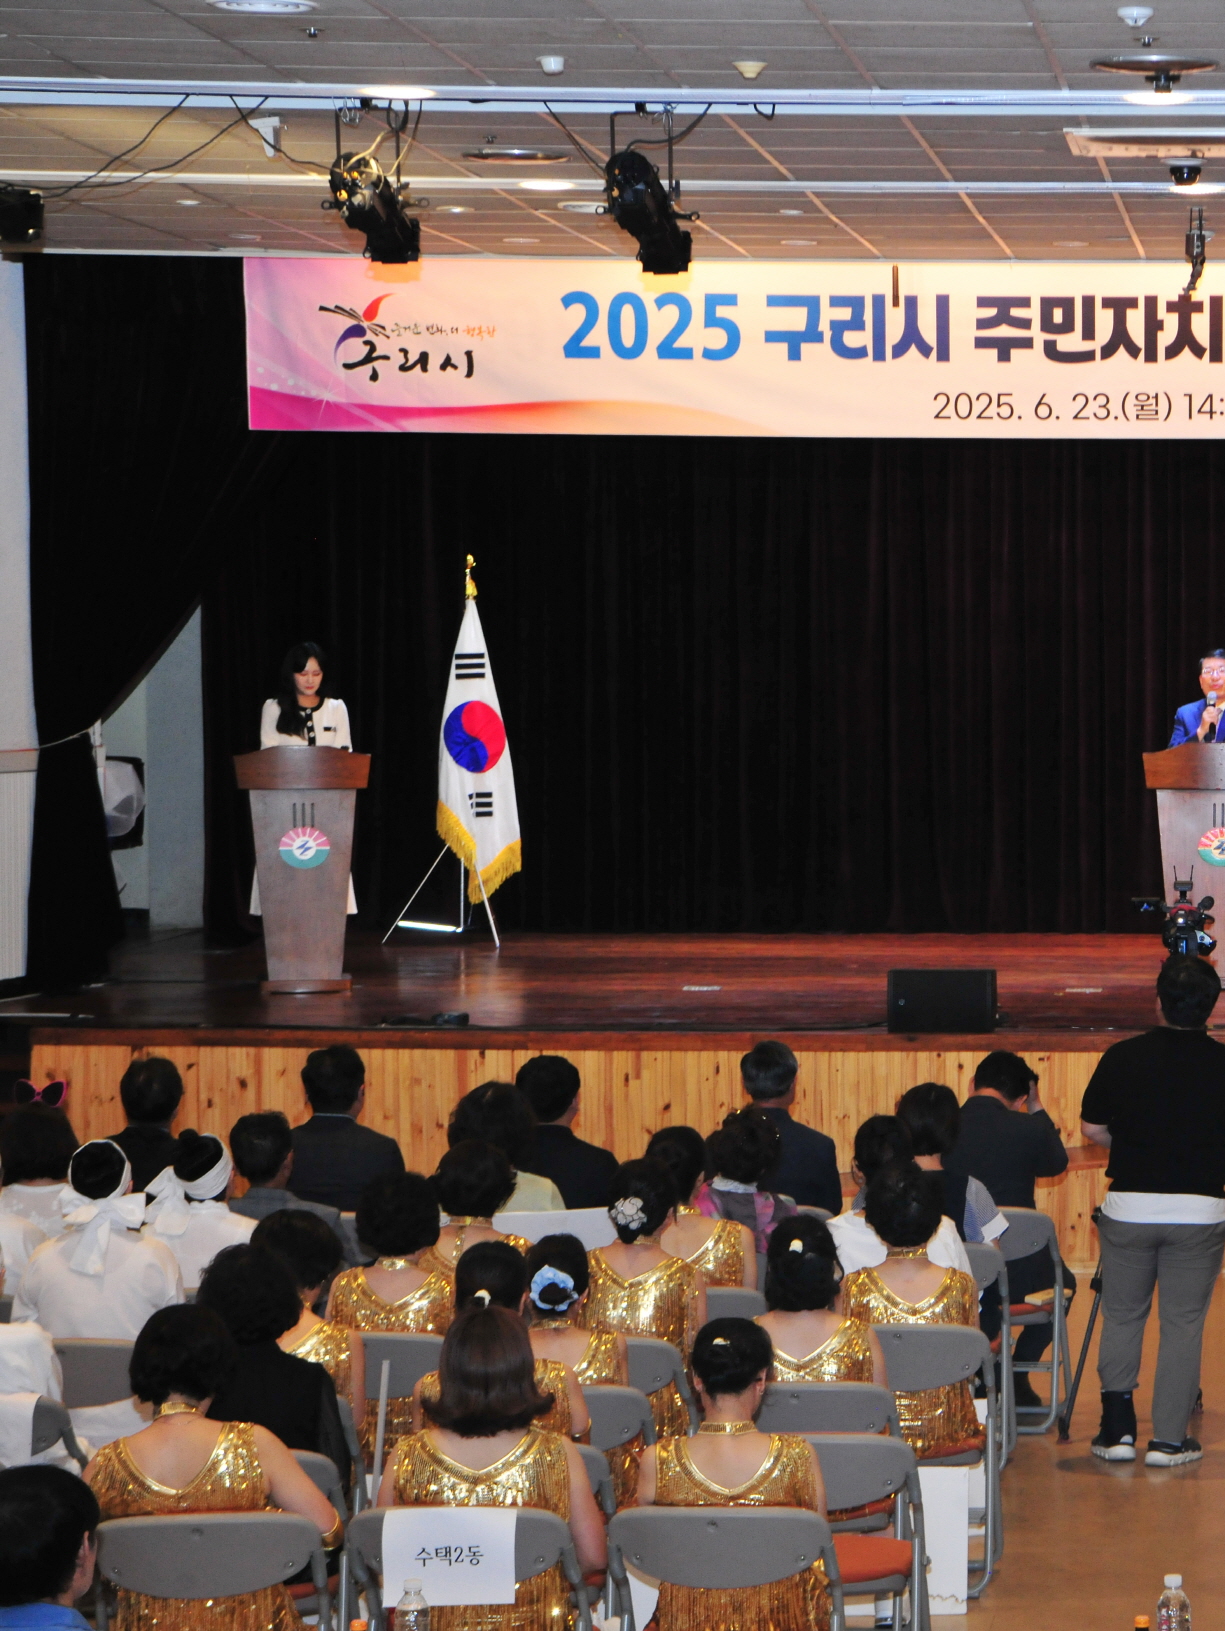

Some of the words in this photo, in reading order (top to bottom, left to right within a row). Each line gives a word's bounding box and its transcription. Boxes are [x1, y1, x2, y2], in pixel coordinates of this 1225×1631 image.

[562, 291, 740, 360] 2025
[765, 294, 950, 362] 구리시
[342, 340, 474, 382] 구리시
[934, 393, 1023, 421] 2025.
[1035, 394, 1061, 421] 6.
[415, 1545, 484, 1568] 수택2동
